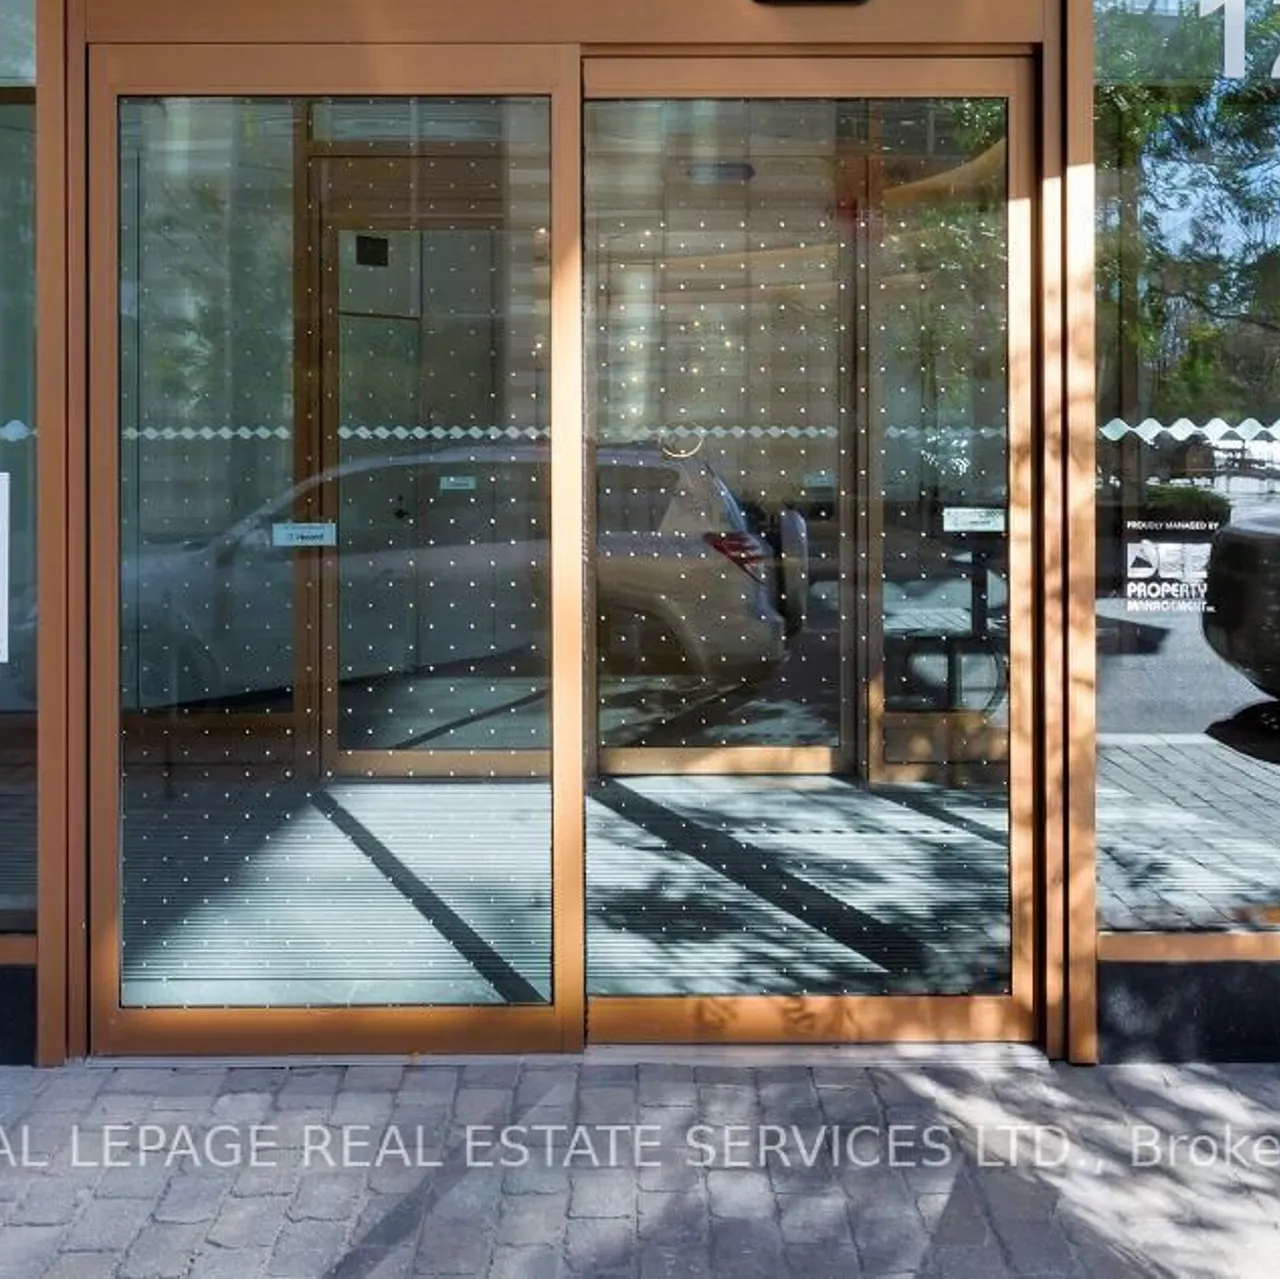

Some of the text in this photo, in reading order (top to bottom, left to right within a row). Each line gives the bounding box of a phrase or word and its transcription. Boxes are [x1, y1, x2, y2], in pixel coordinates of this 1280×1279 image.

[1126, 521, 1219, 530] PROUDLY MANAGED BY
[1127, 581, 1208, 599] PROPERTY
